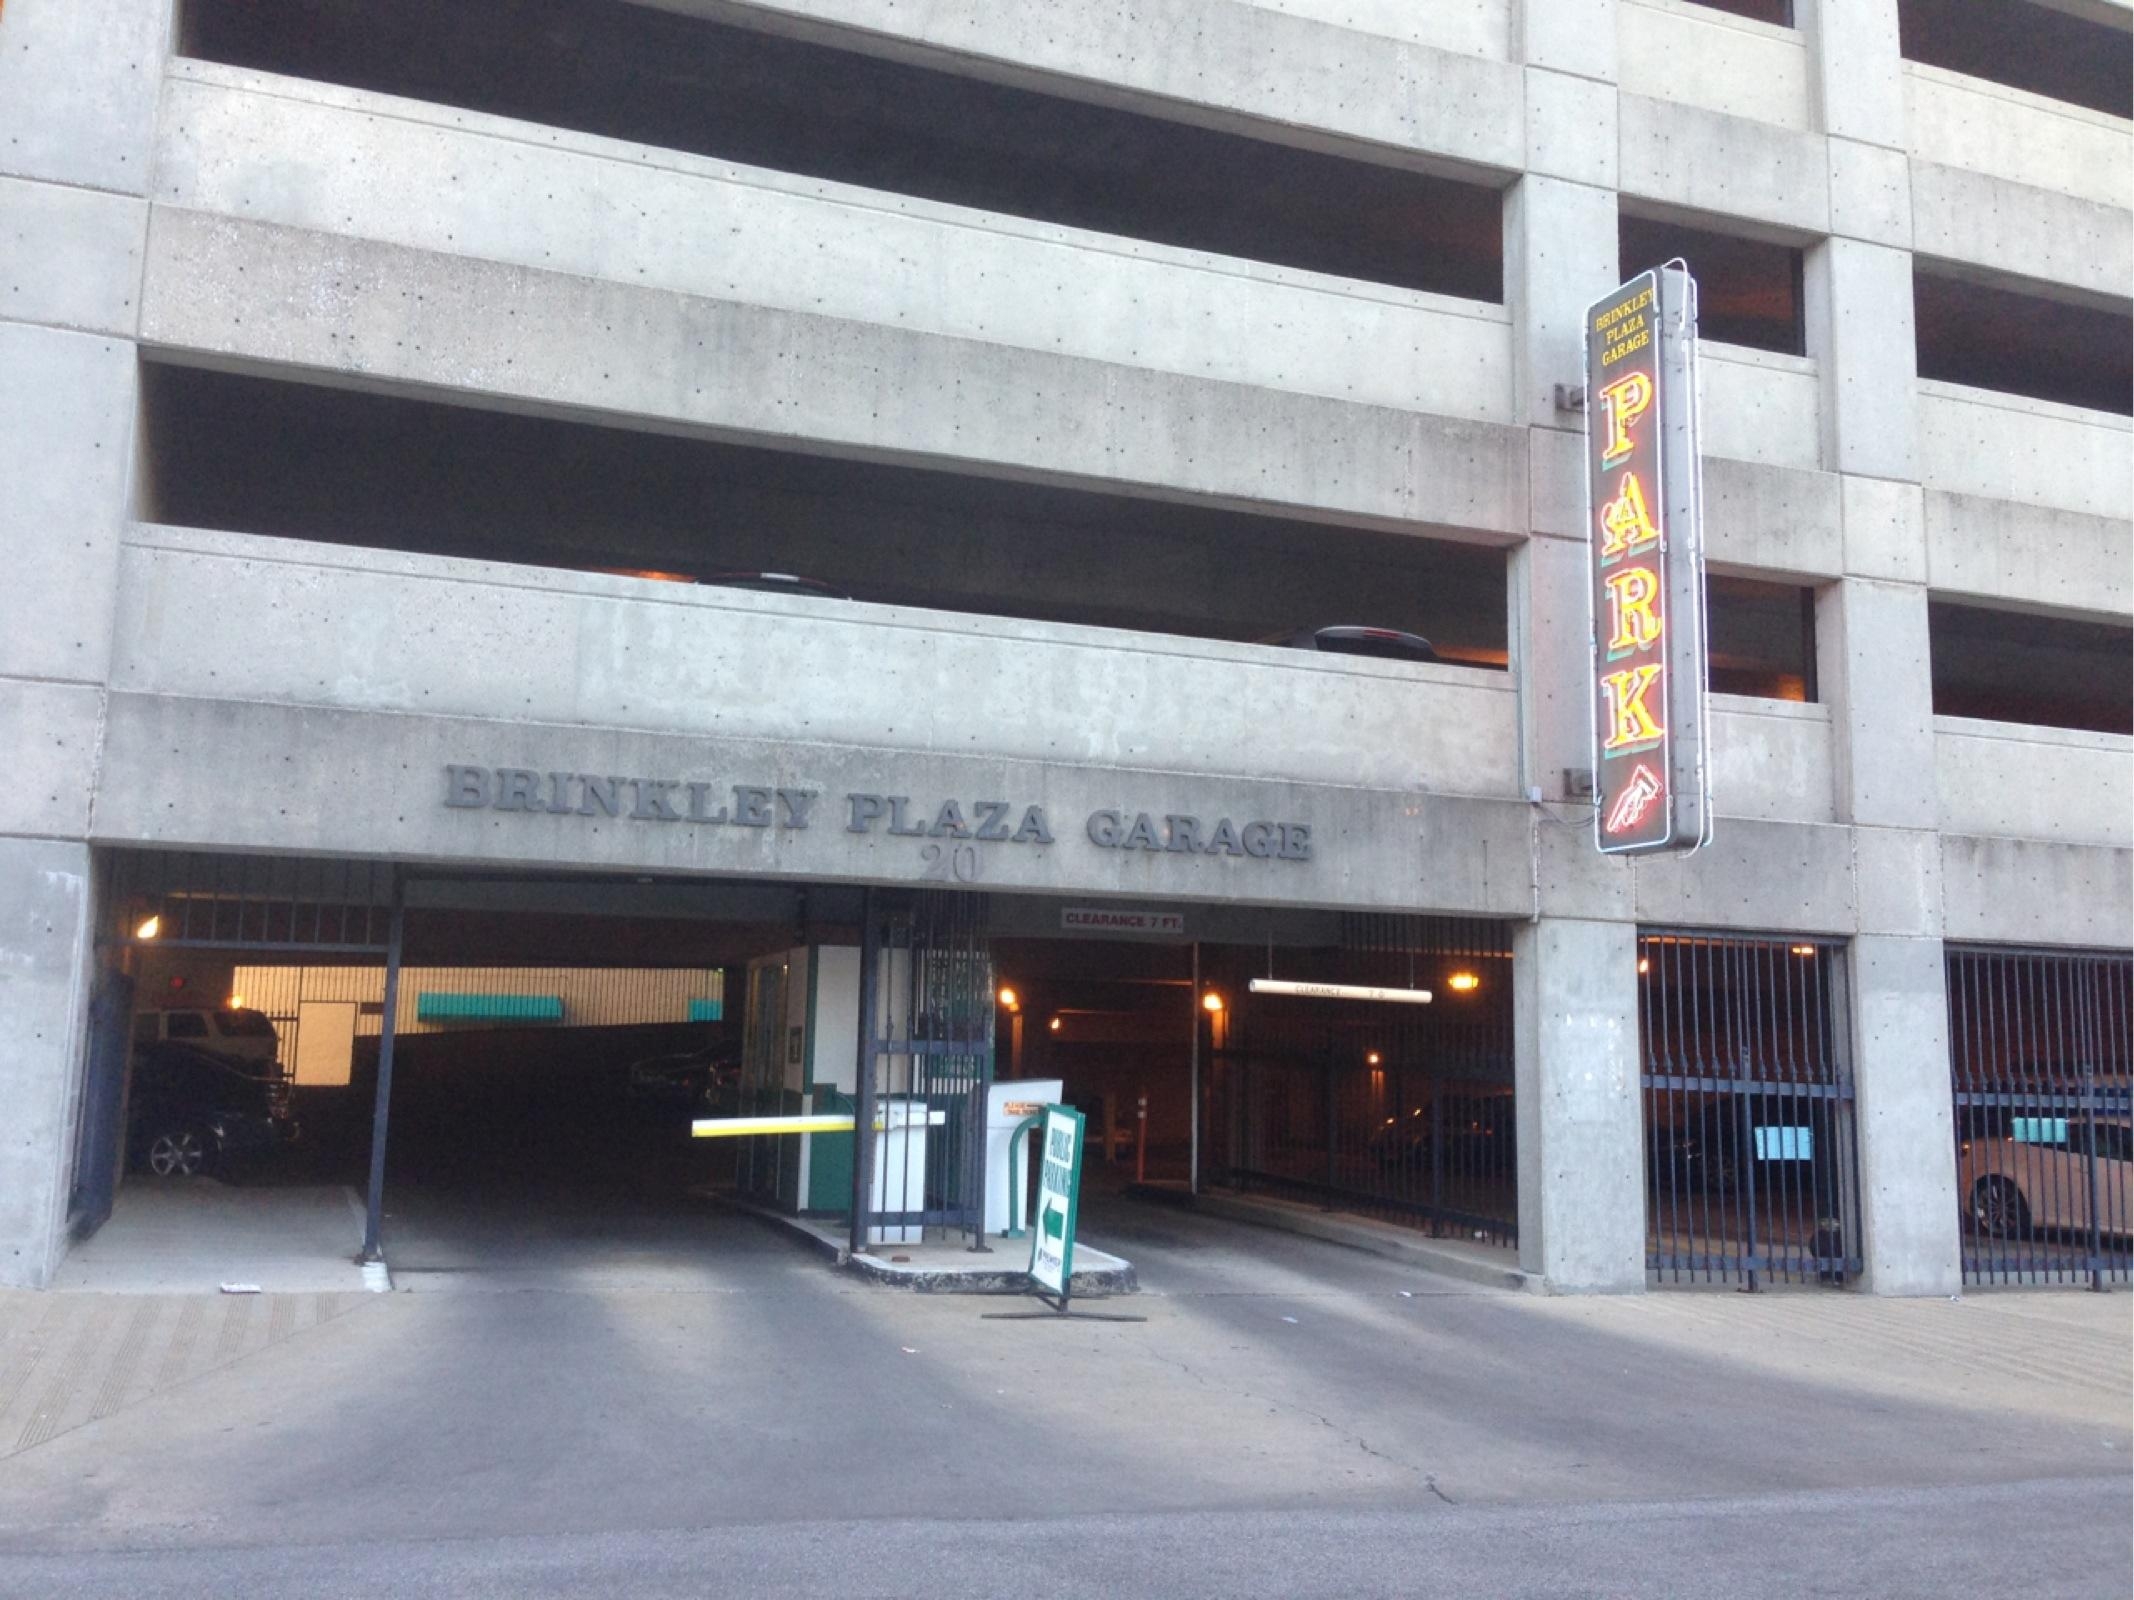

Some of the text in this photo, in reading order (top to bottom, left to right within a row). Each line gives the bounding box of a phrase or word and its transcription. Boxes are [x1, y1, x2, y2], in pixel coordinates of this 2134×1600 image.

[1602, 329, 1649, 366] GARAGE
[1606, 314, 1644, 345] PLAZA
[1598, 371, 1666, 750] PARK
[444, 764, 1313, 861] BRINKLEY PLAZA GARAGE
[920, 843, 983, 882] 20
[1066, 912, 1145, 928] CLEARANCE
[1151, 917, 1158, 929] 7
[1049, 1128, 1072, 1163] PUBLIC
[1043, 1159, 1071, 1197] PARKING
